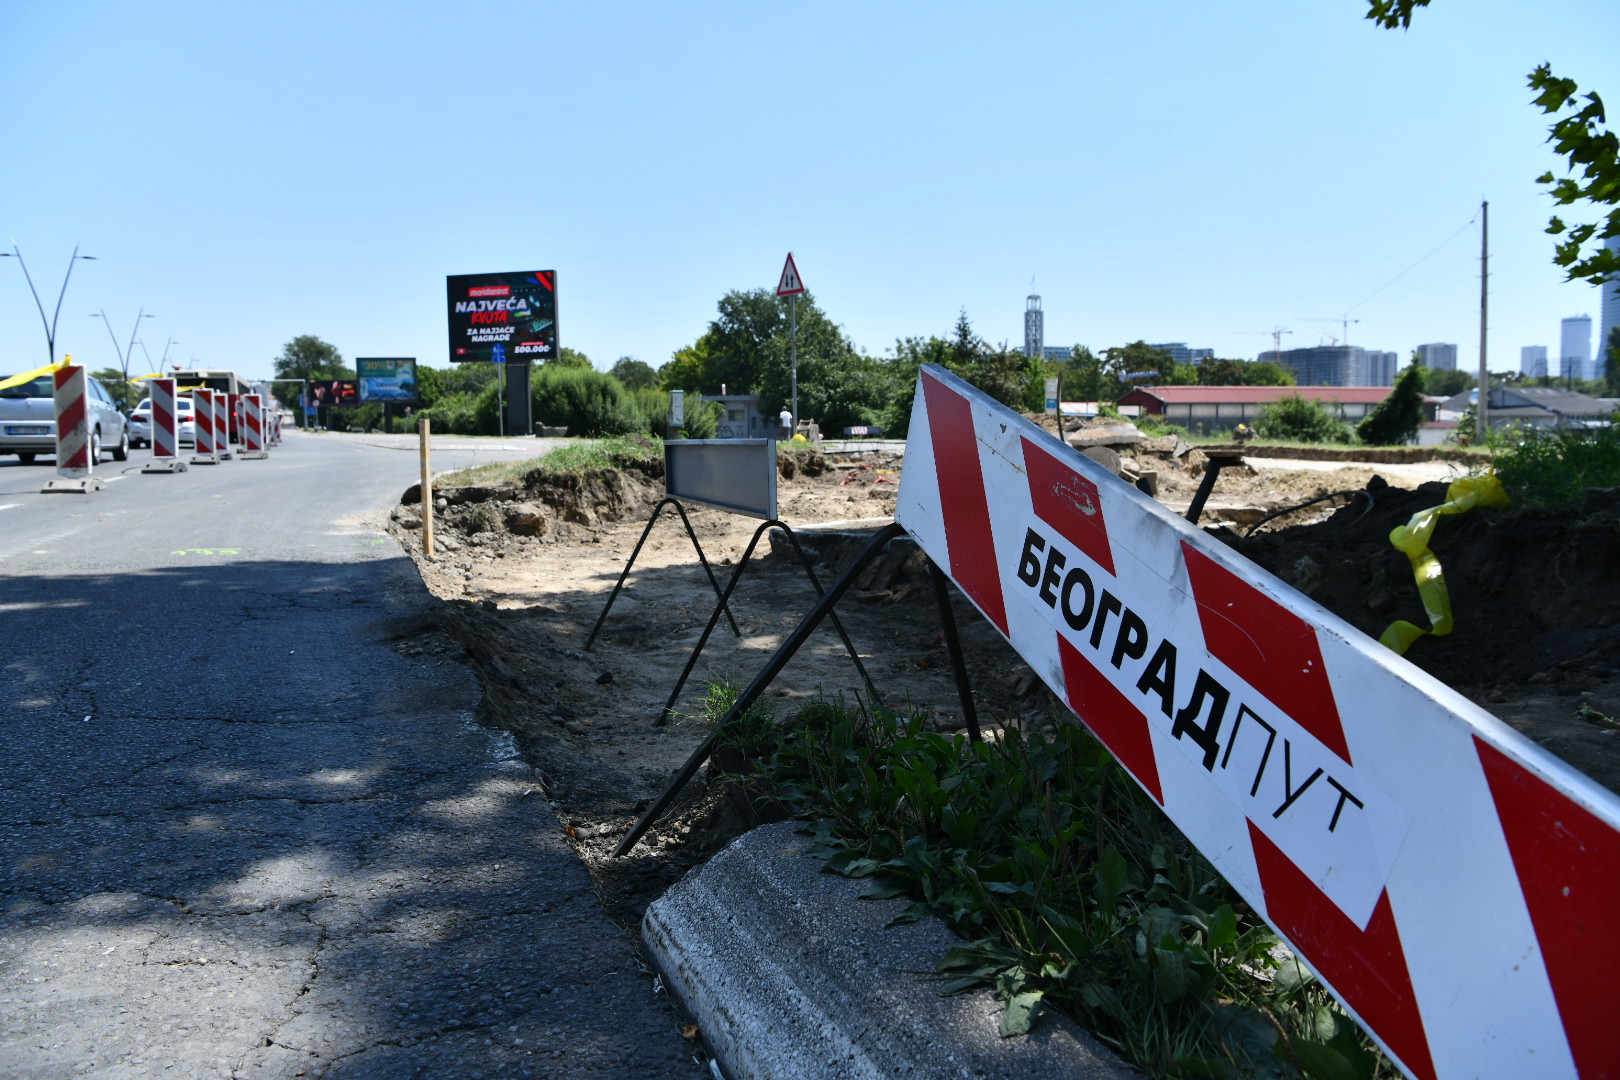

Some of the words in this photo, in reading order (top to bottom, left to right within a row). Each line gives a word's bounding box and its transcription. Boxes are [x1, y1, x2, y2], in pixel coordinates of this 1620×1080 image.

[455, 297, 527, 313] NAJVEĆA
[471, 310, 508, 325] KVOTA
[466, 328, 478, 336] ZA
[471, 334, 511, 343] NAGRADE
